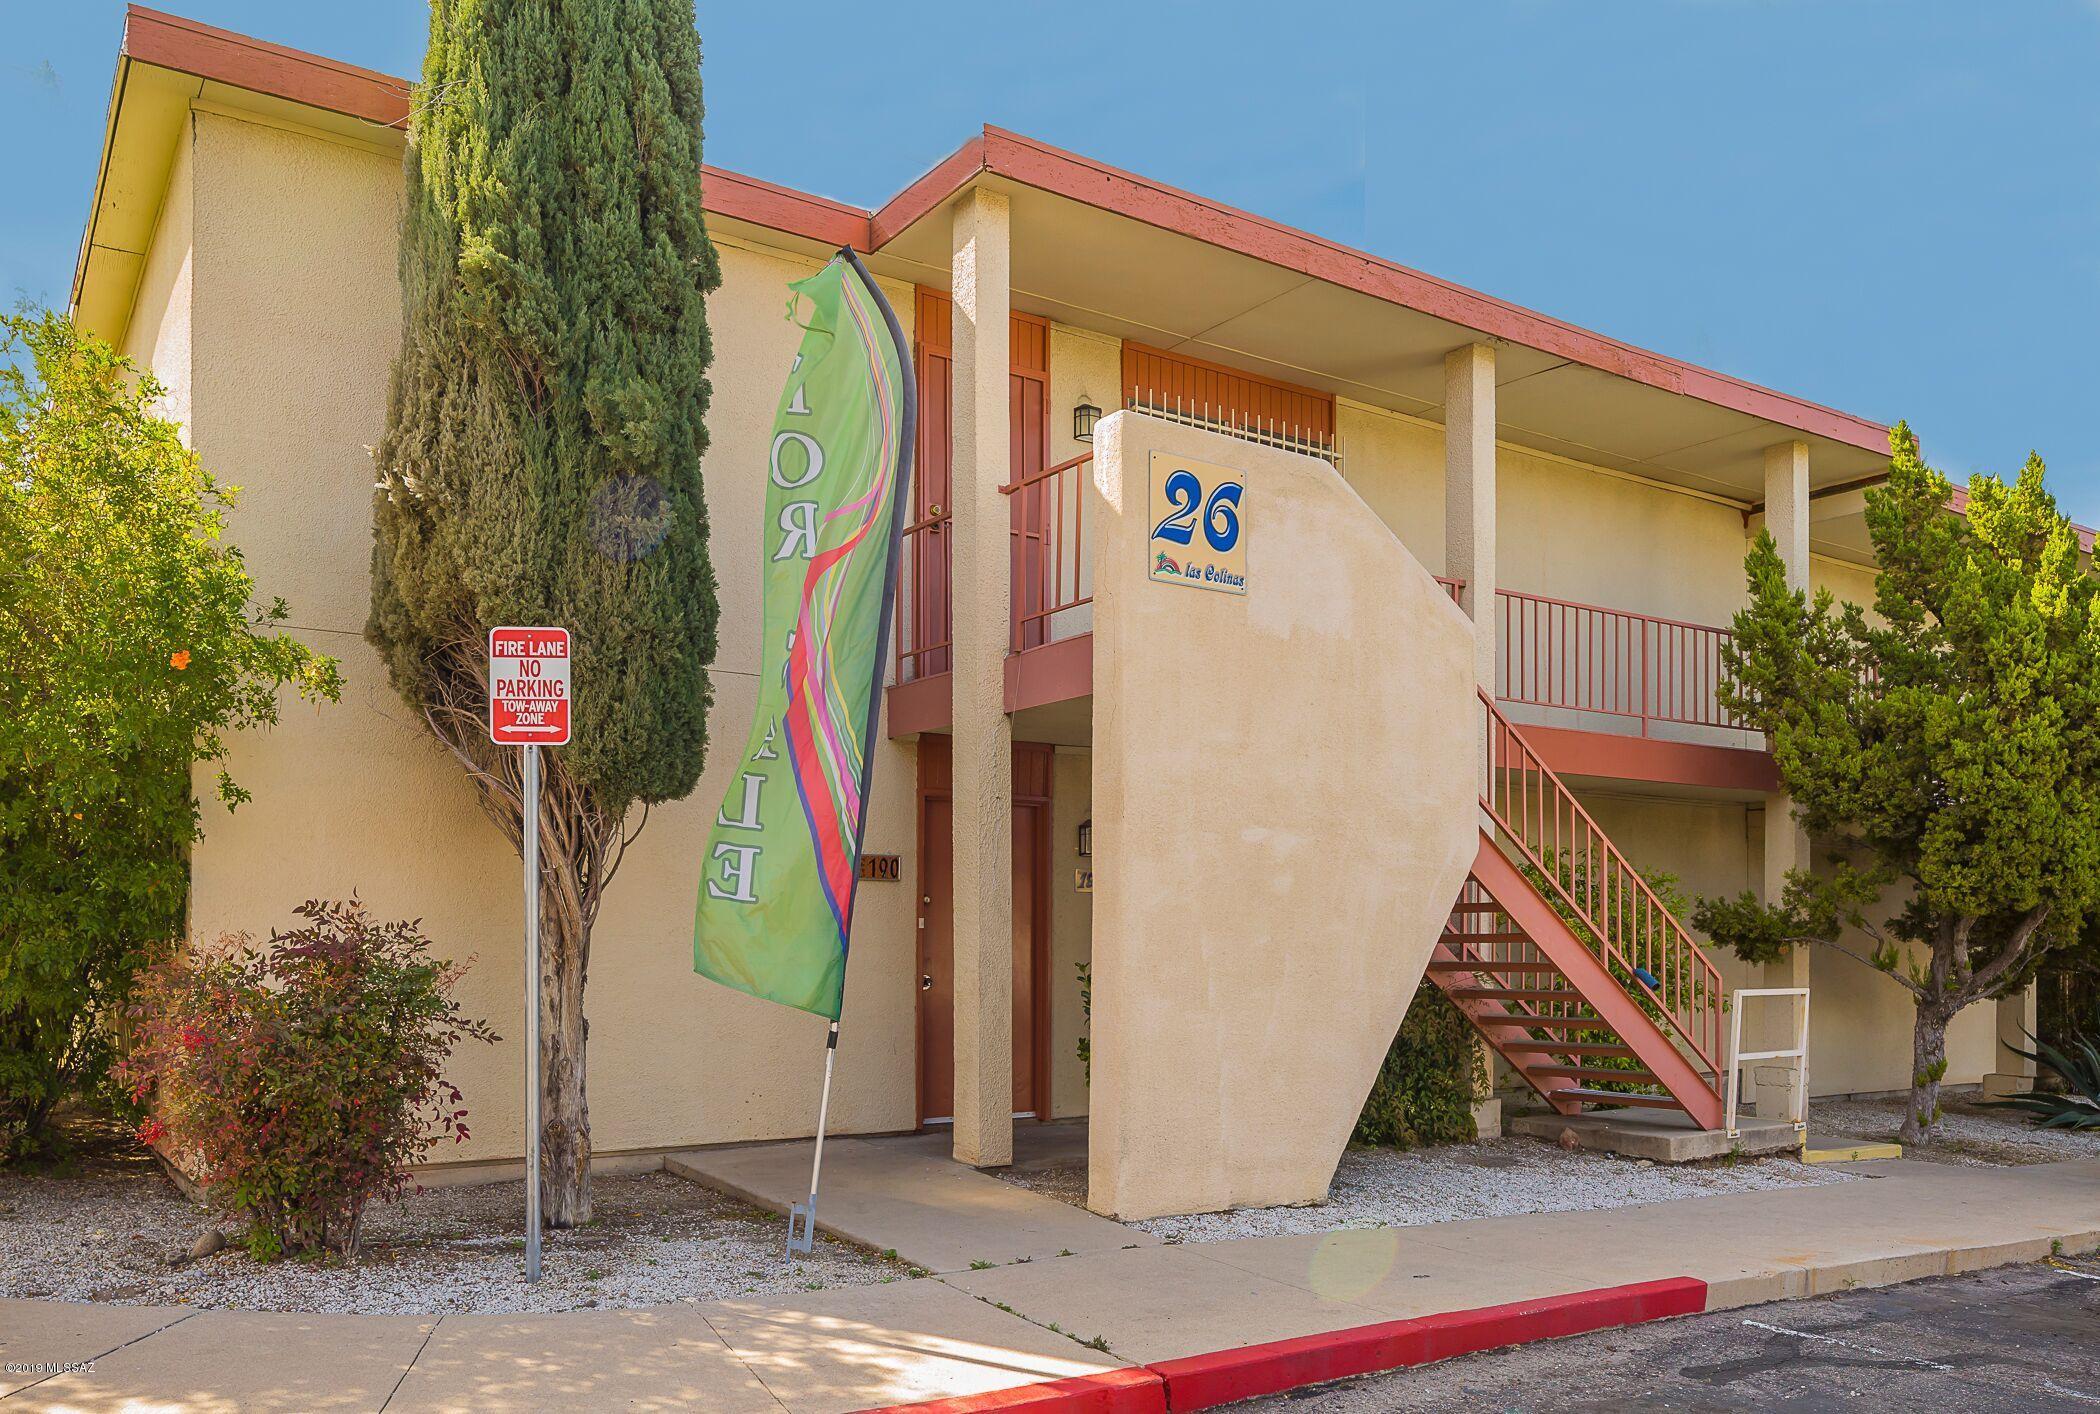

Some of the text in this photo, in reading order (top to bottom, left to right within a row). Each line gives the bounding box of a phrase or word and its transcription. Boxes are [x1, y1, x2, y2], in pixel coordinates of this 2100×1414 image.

[1151, 469, 1244, 553] 26
[1204, 563, 1246, 587] Colinas
[495, 640, 565, 656] FIRE LANE
[519, 659, 541, 678] NO
[496, 679, 564, 698] PARKING
[502, 700, 559, 712] TOW-AWAY
[515, 712, 546, 725] ZONE
